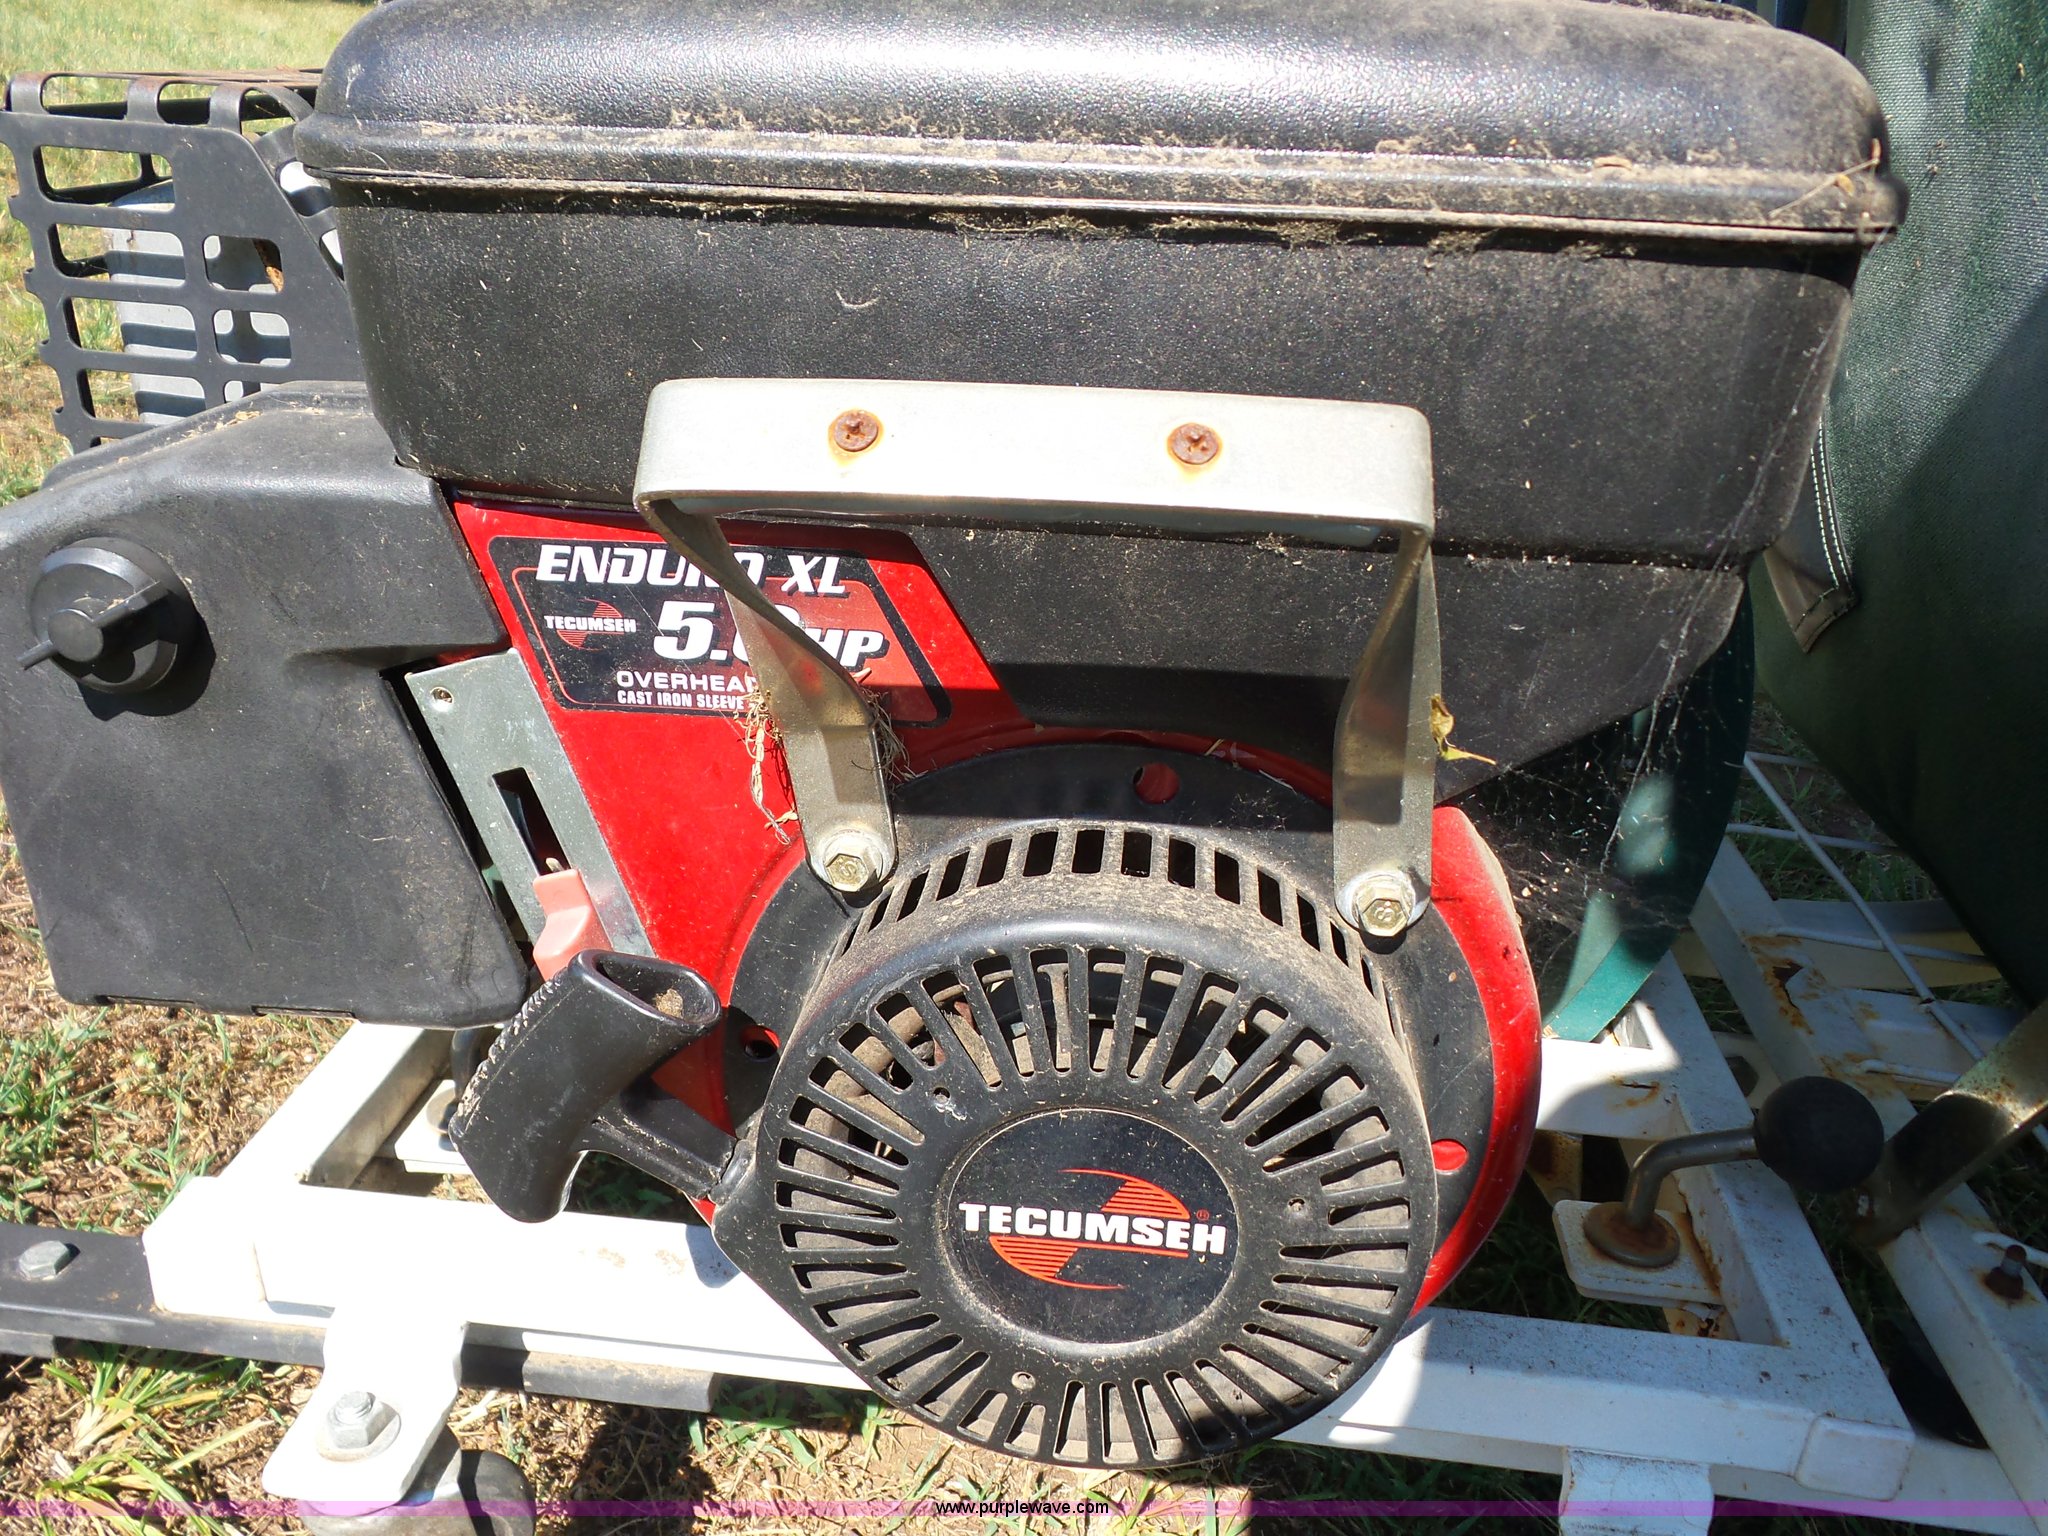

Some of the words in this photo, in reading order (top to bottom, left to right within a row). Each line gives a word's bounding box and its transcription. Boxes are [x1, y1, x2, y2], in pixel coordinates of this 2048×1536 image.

[780, 554, 847, 594] XL
[543, 615, 637, 633] TECUMSEH
[617, 690, 652, 705] CAST
[657, 692, 692, 708] IRON
[696, 693, 745, 710] SLEEVE
[958, 1202, 1227, 1255] TECUMSEH
